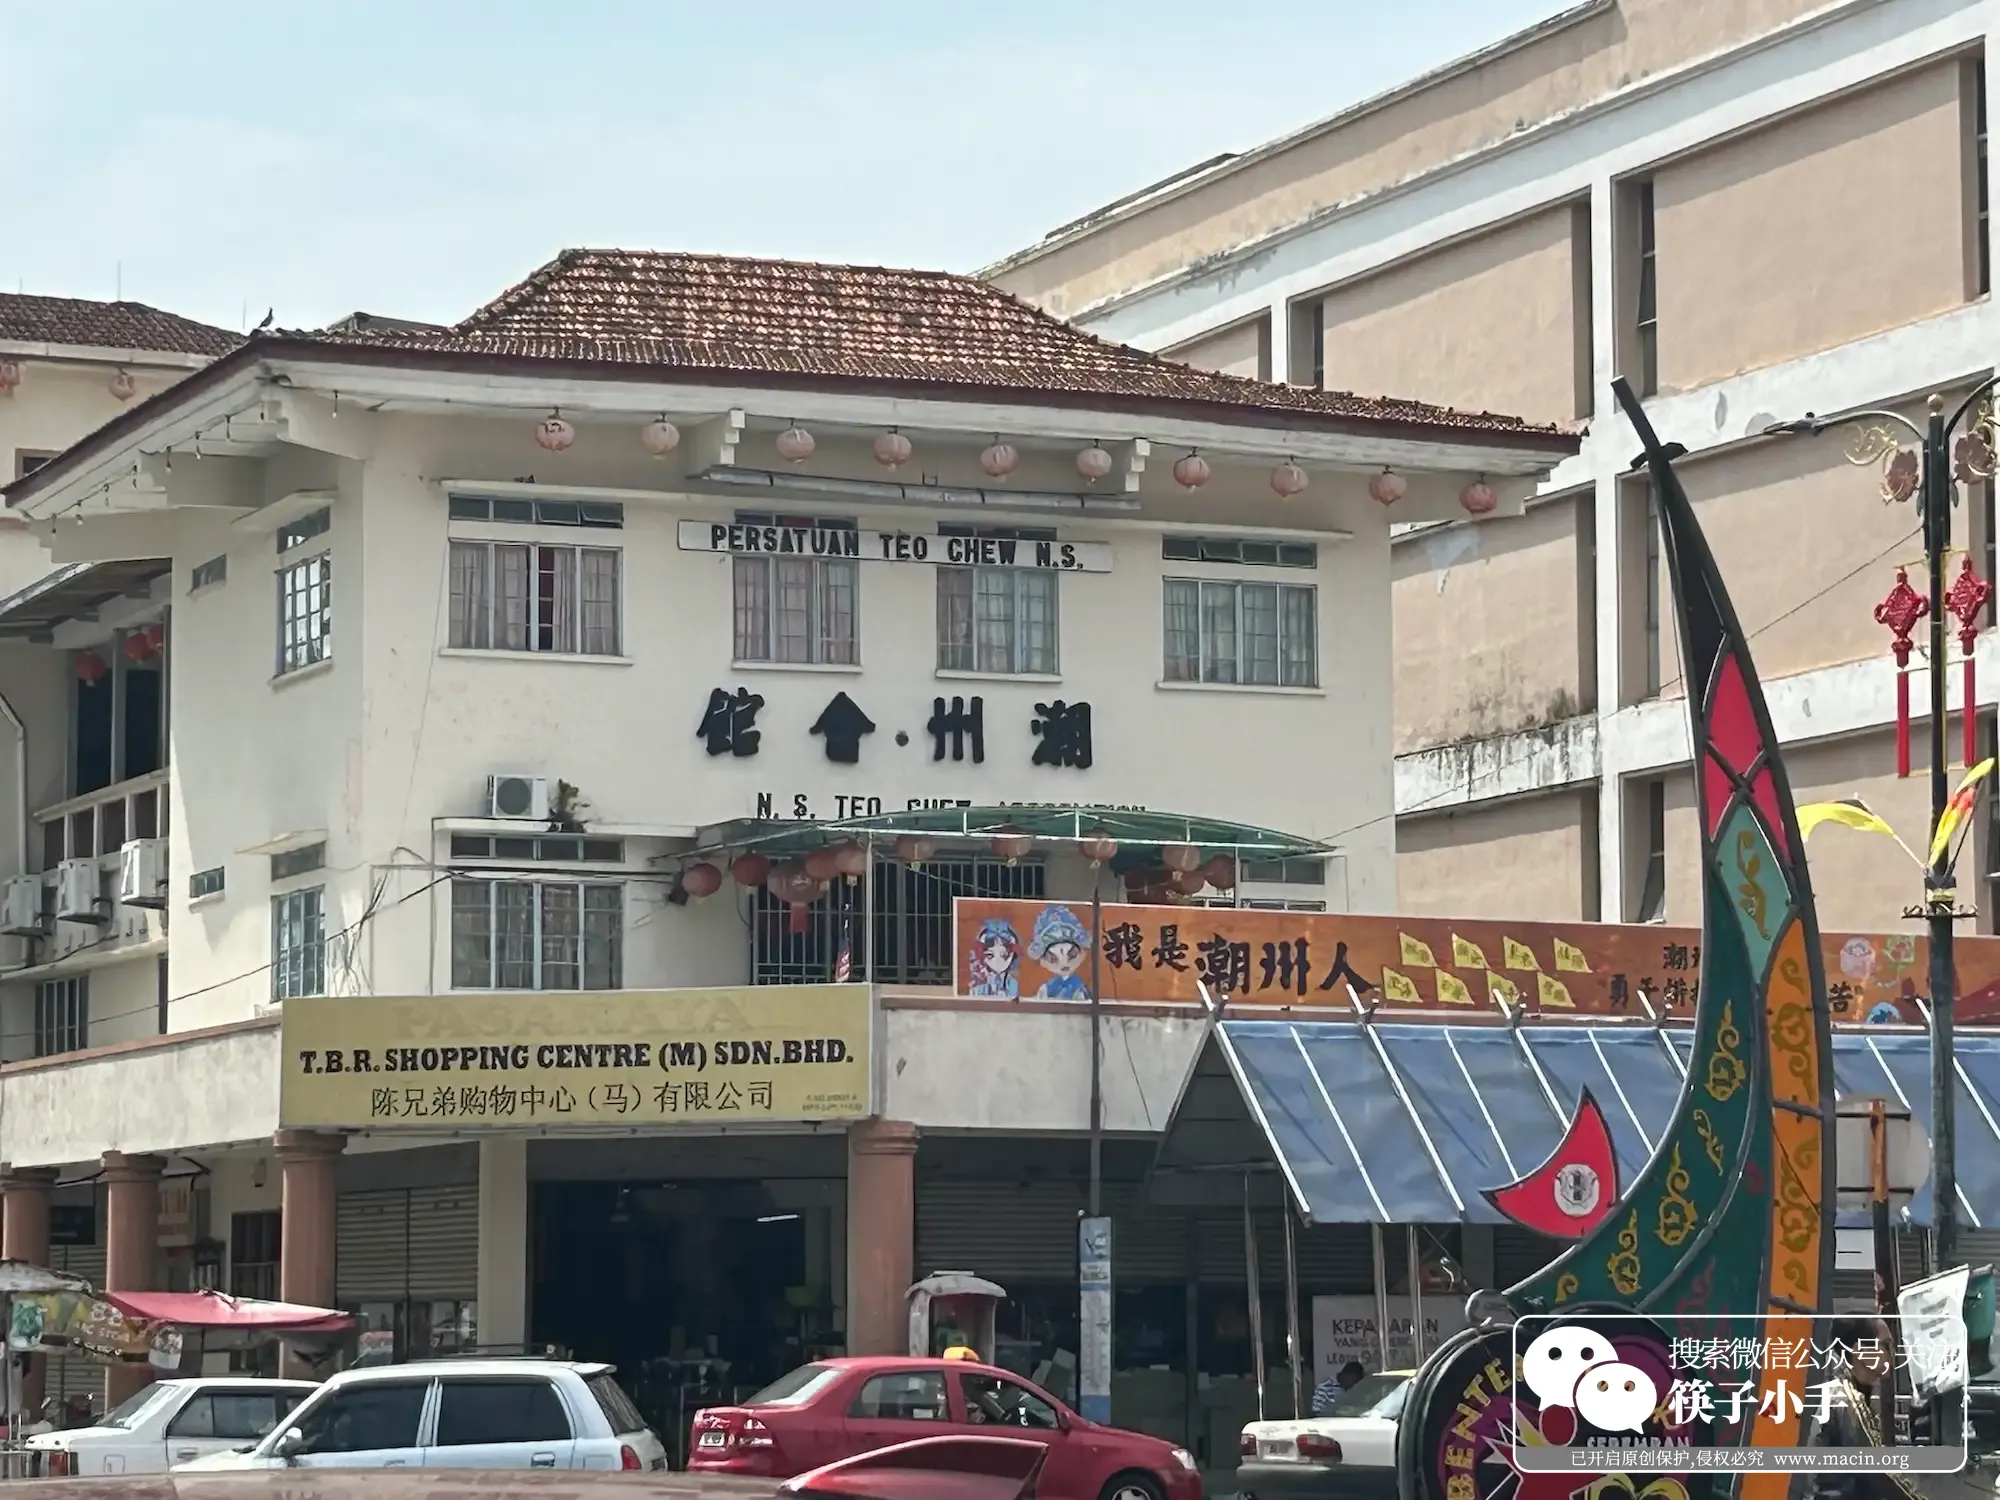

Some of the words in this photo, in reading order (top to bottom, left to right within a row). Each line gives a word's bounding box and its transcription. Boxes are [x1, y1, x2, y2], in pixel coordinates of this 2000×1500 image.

[711, 524, 859, 556] PERSATUAN
[879, 533, 928, 560] TEO
[947, 538, 1017, 565] CHEW
[1036, 542, 1083, 569] N.S.
[1103, 921, 1377, 996] 我是潮州人
[300, 1050, 381, 1074] T.B.R.
[385, 1045, 529, 1072] SHOPPING
[536, 1044, 651, 1069] CENTRE
[658, 1042, 707, 1072] (M)
[371, 1080, 773, 1117] 陈兄弟购物中心（马）有限公司
